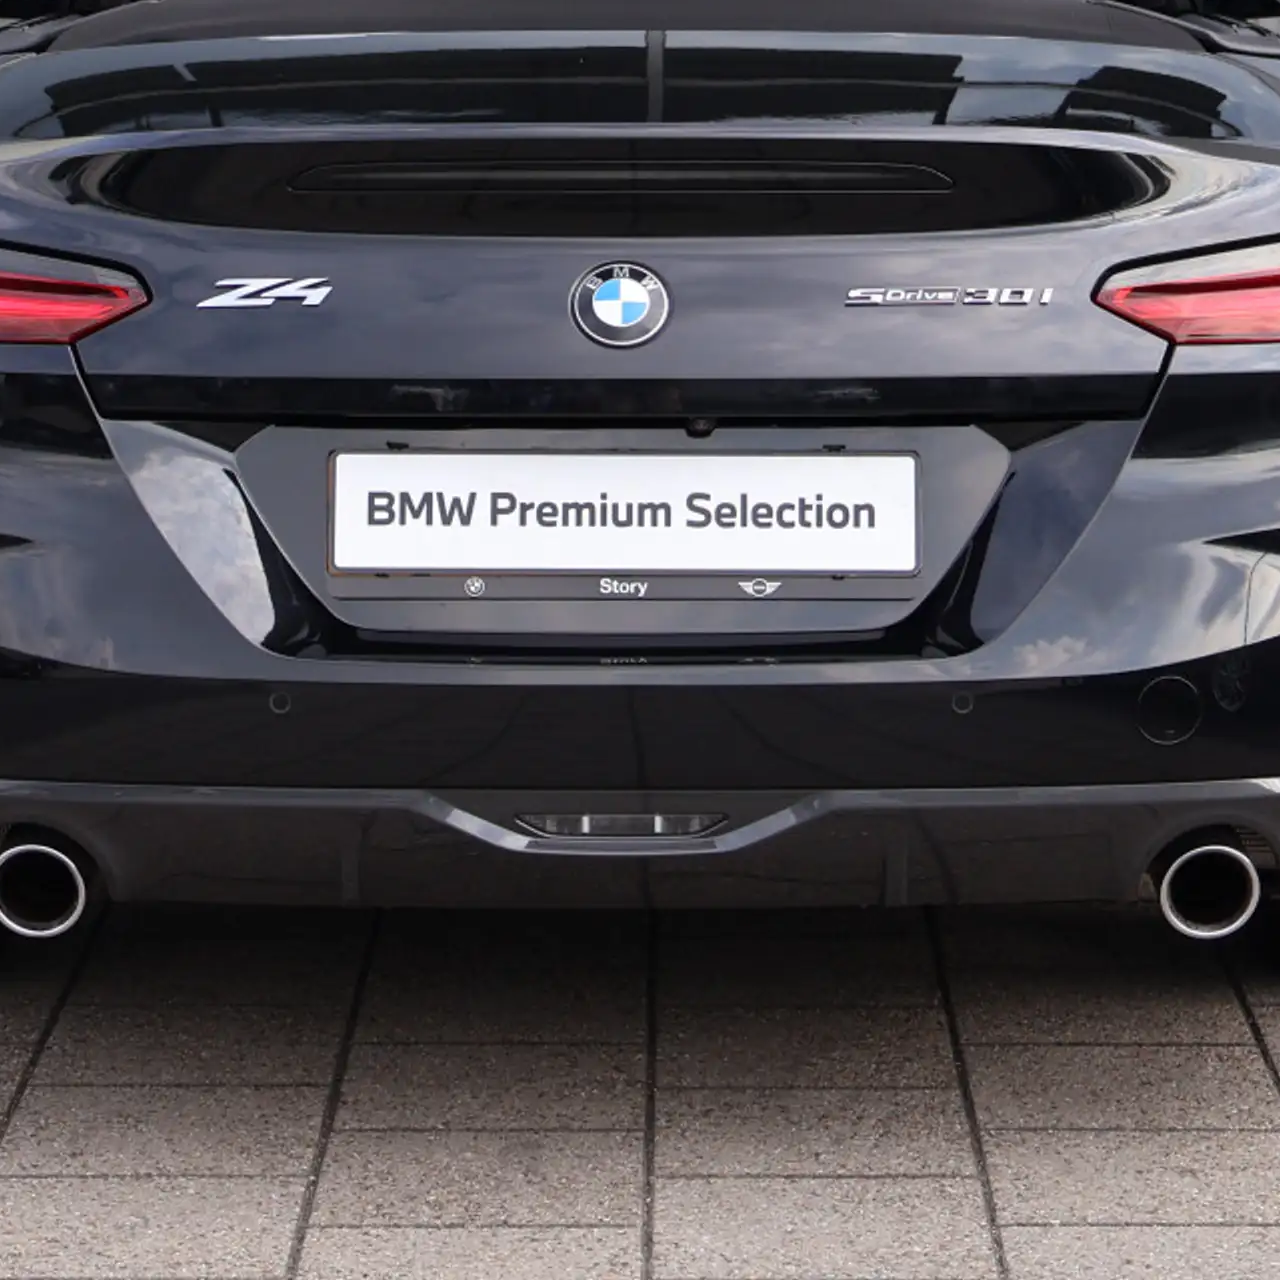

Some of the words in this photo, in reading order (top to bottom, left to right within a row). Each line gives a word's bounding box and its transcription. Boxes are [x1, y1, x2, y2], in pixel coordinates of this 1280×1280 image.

[196, 277, 333, 308] Z4
[585, 267, 660, 291] BMW
[367, 492, 476, 526] BMW
[491, 492, 671, 528] Premium
[686, 493, 875, 529] Selection
[599, 578, 648, 597] Story
